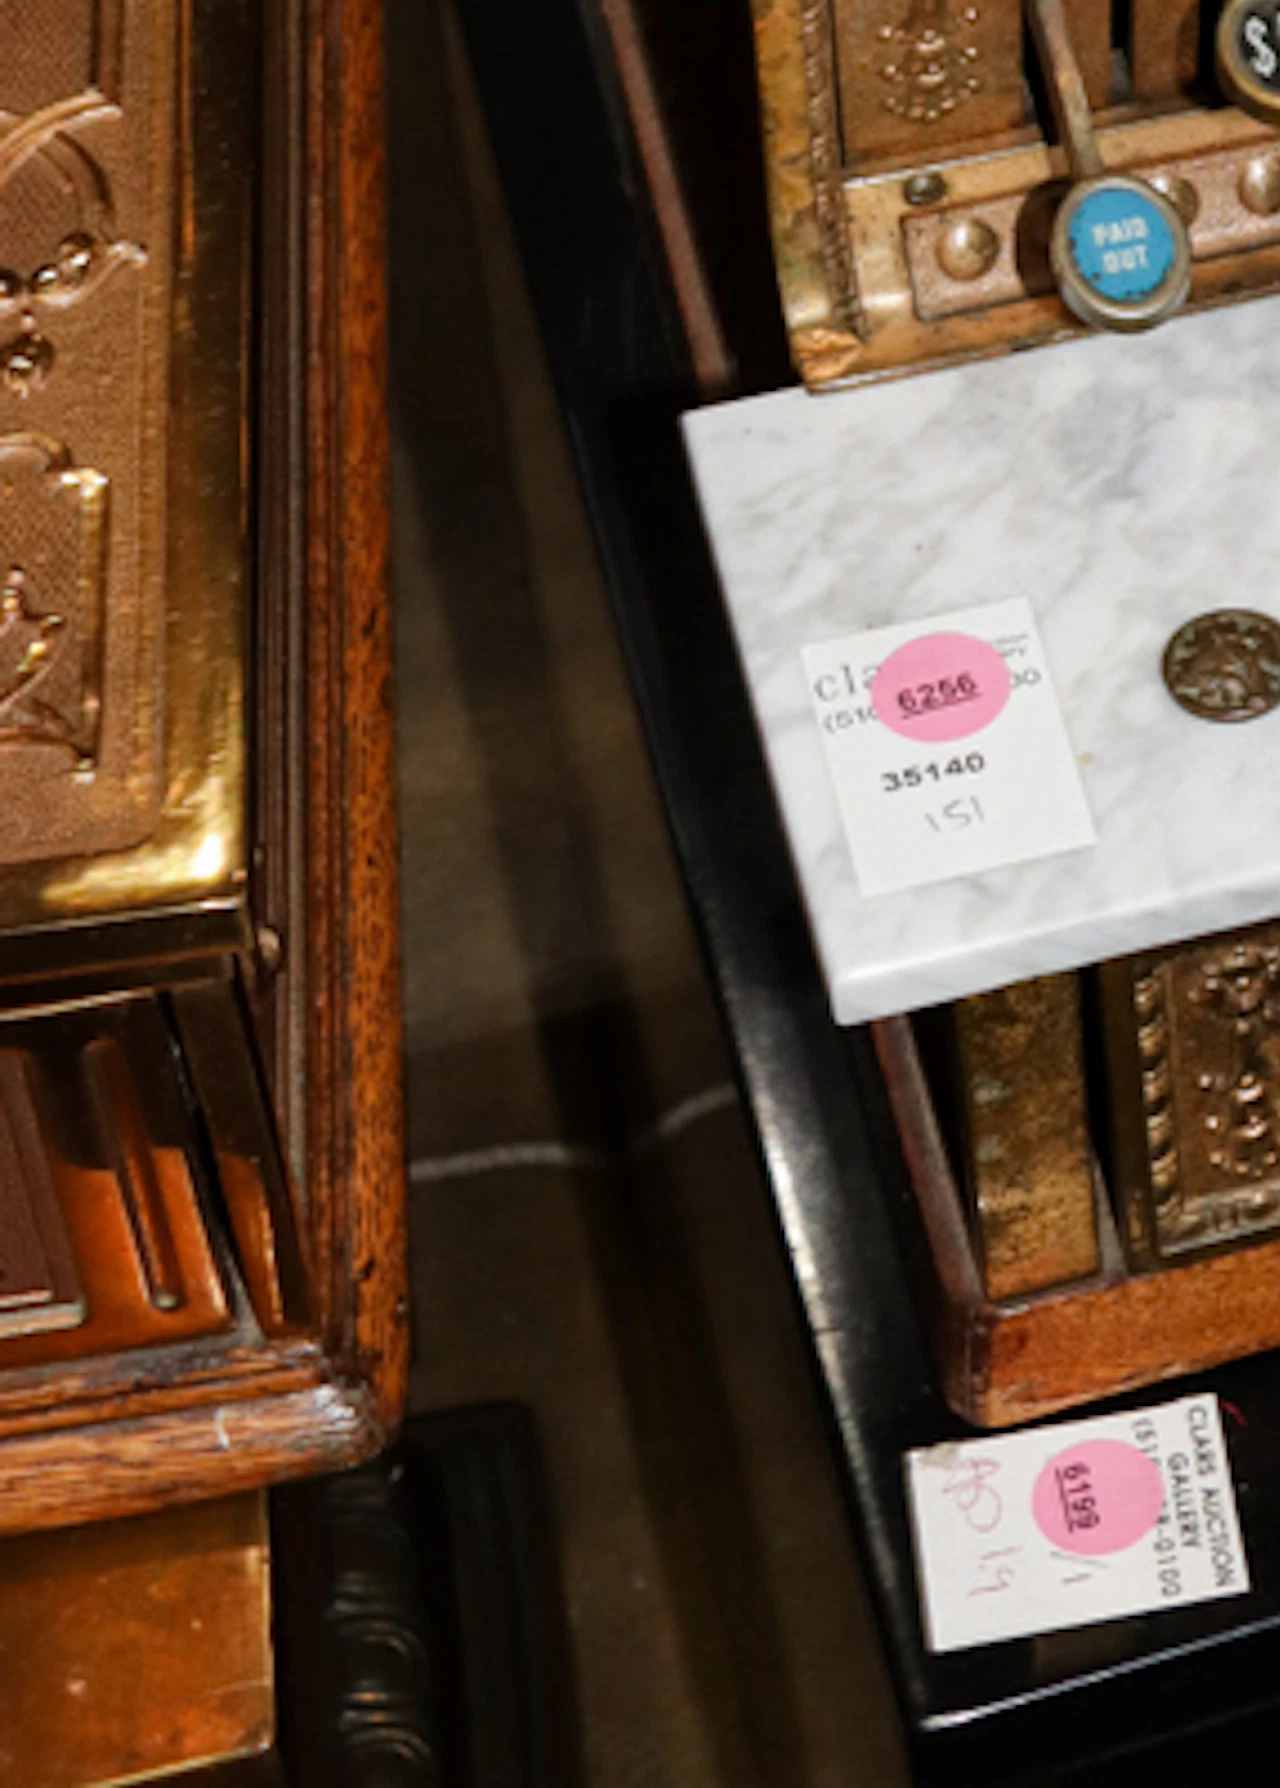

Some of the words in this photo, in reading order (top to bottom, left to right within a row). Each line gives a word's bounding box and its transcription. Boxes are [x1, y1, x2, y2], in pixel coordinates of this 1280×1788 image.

[1092, 216, 1148, 247] PAID
[1102, 244, 1149, 274] OUT
[896, 670, 979, 714] 6256
[880, 750, 986, 793] 35140
[1060, 1462, 1101, 1531] 6199
[1167, 1452, 1201, 1549] GALLERY
[1201, 1487, 1236, 1589] AUCTION
